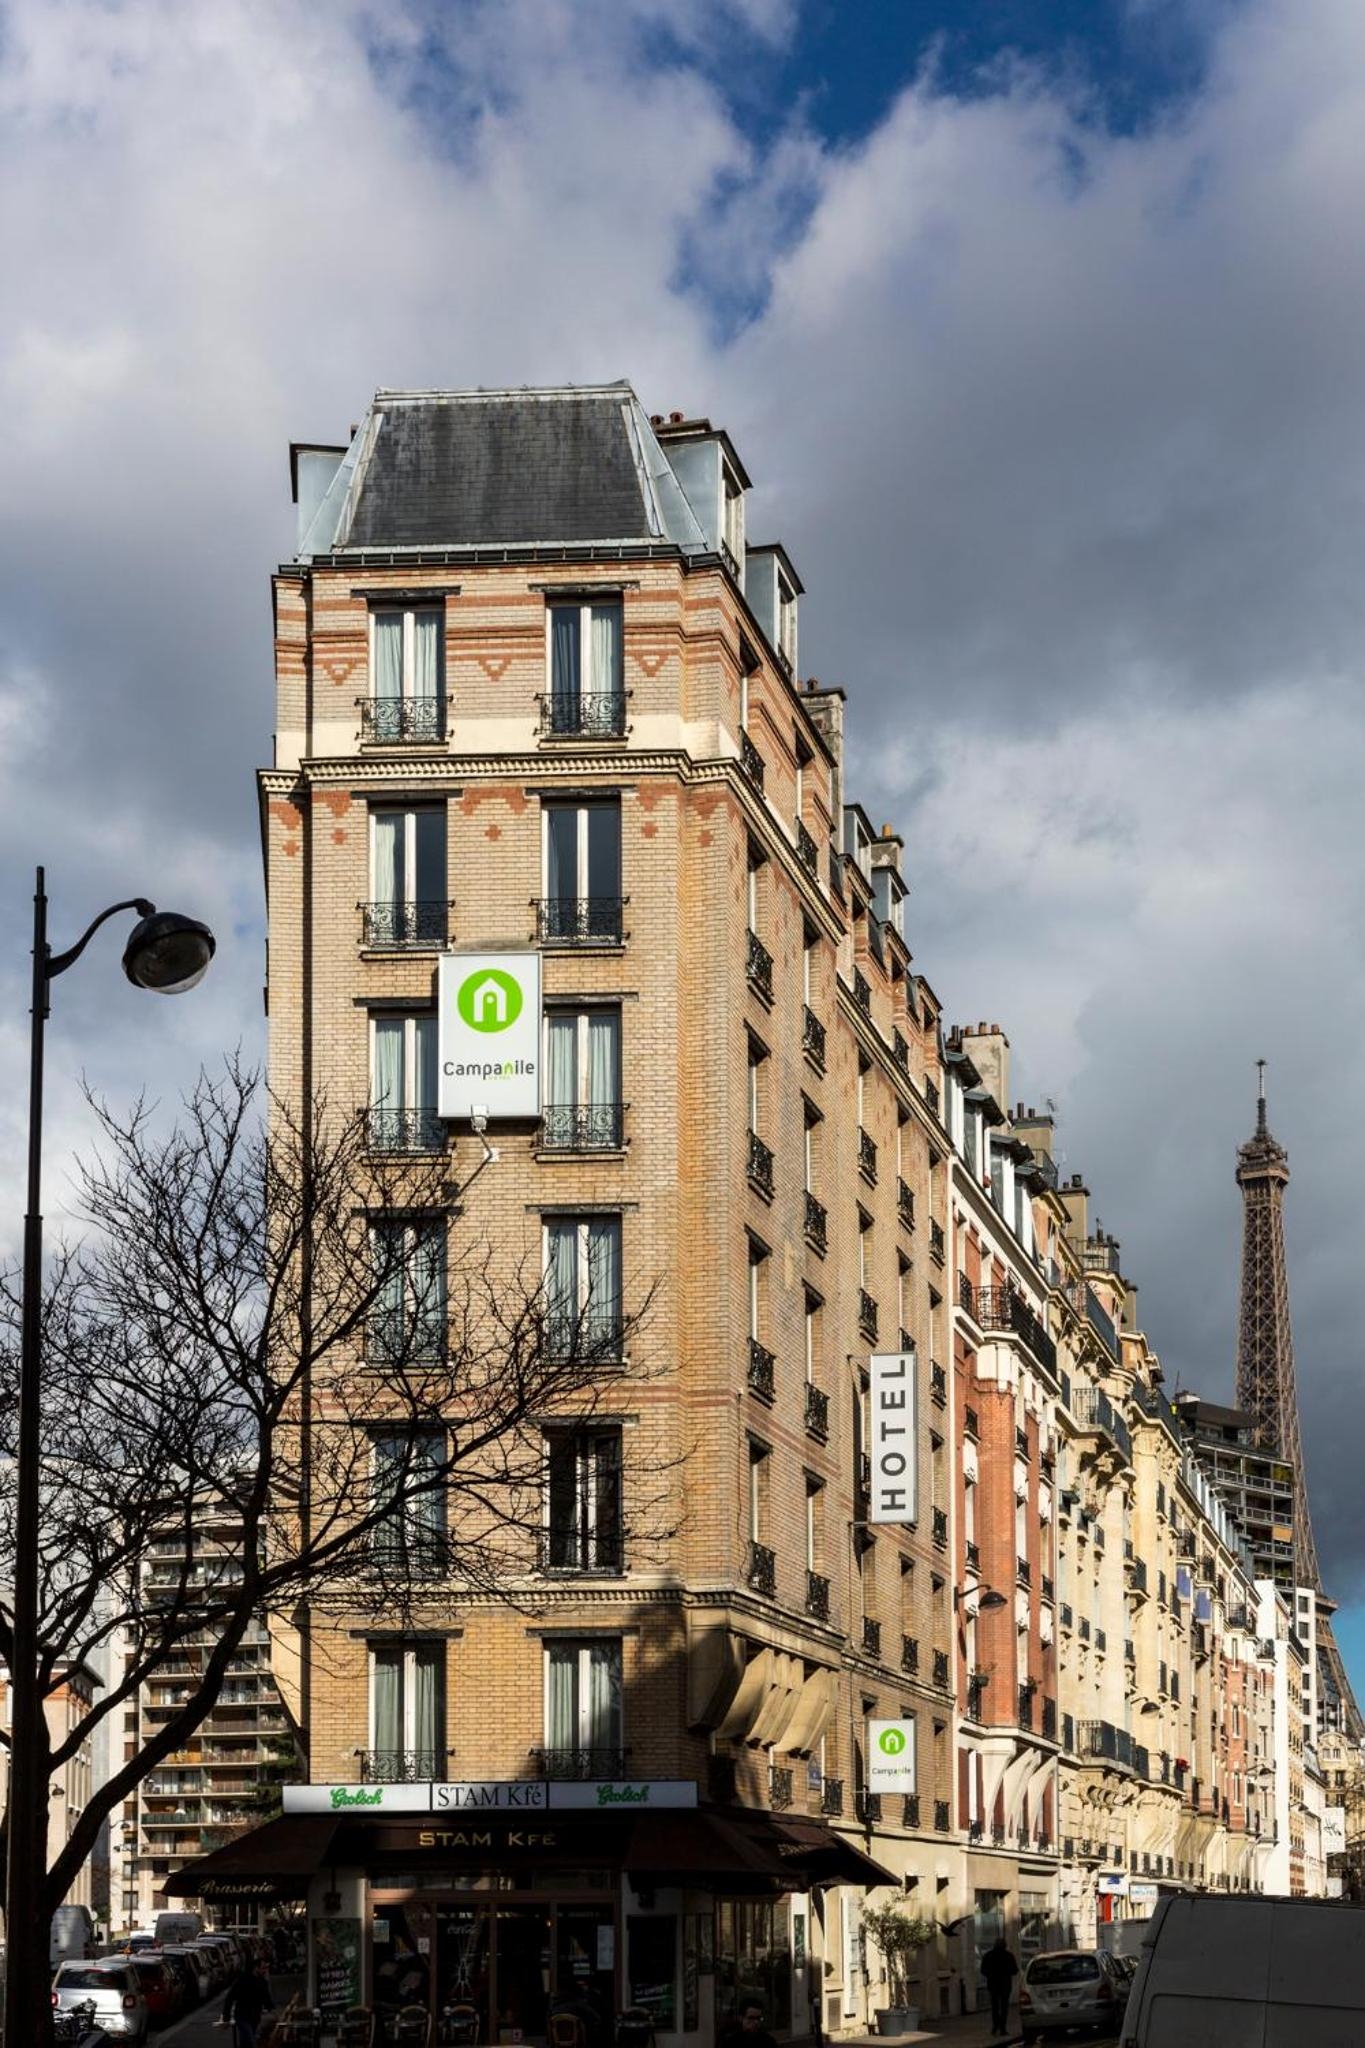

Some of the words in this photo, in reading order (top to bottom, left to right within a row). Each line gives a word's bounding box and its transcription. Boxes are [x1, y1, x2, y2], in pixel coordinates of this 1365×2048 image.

[443, 1060, 535, 1080] Campanile
[880, 1359, 906, 1511] HOTEL
[437, 1786, 499, 1807] STAM
[507, 1784, 542, 1806] Kfé
[419, 1832, 492, 1847] STAM
